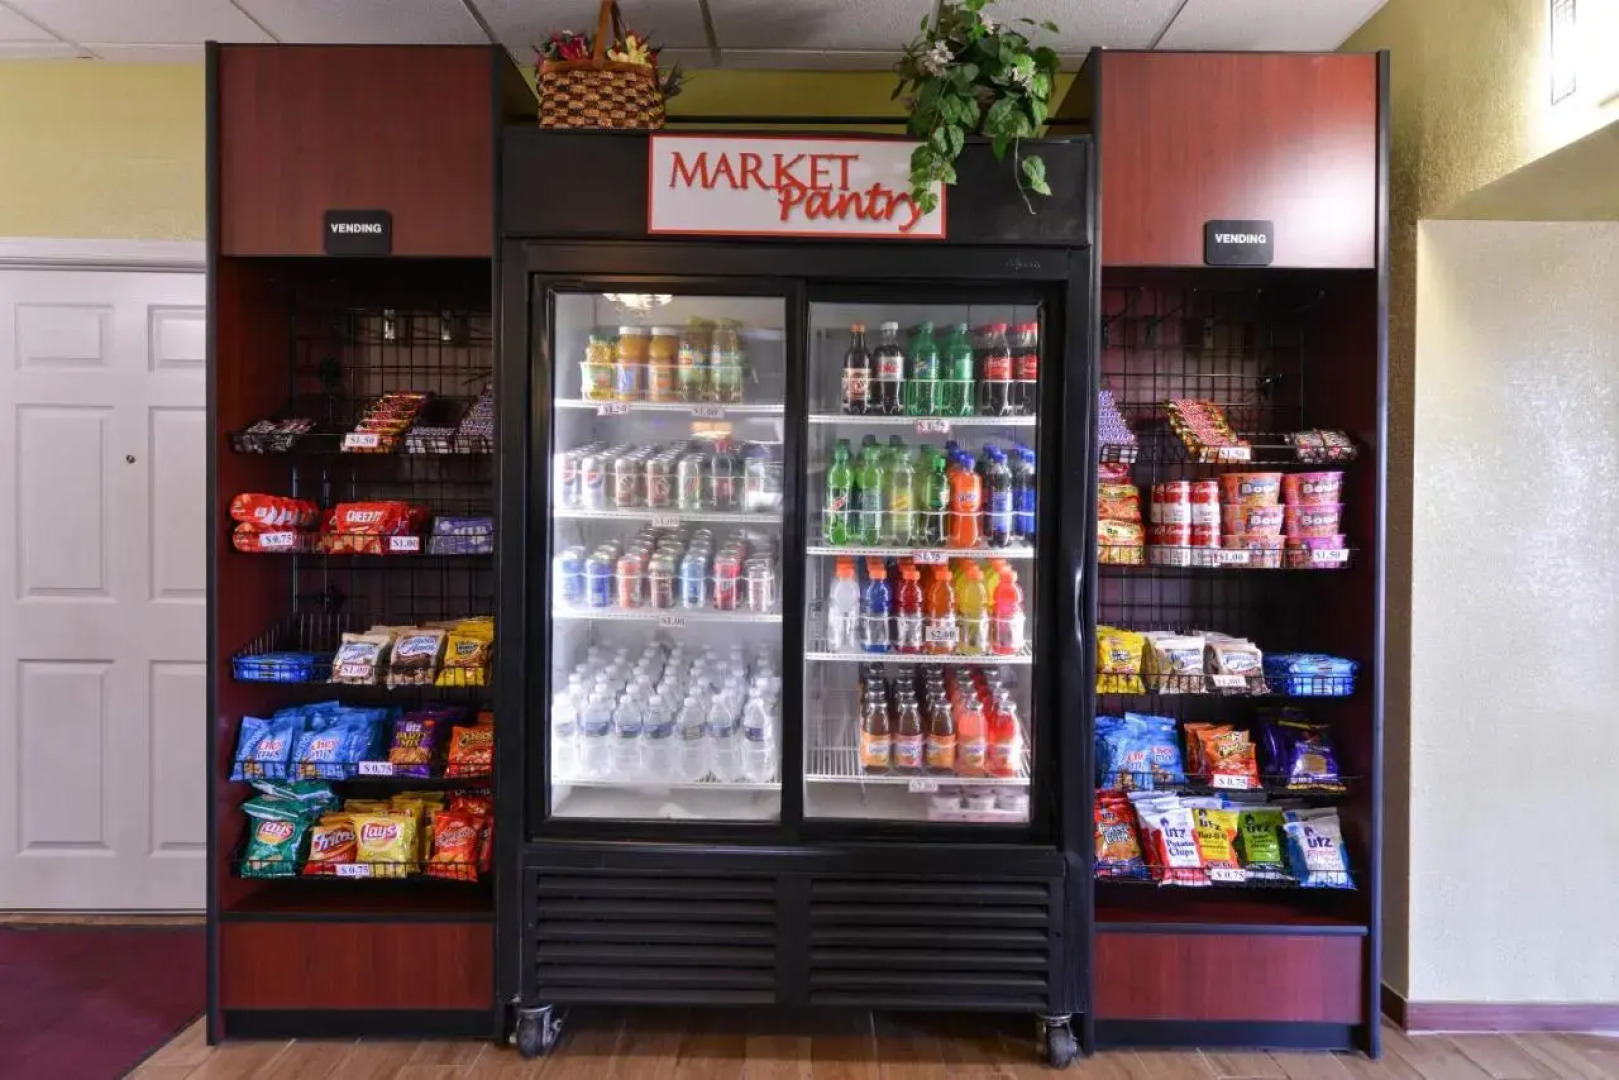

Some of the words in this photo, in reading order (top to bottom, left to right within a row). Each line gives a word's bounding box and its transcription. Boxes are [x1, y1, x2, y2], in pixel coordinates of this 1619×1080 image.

[669, 151, 859, 190] MARKET
[778, 181, 923, 232] Pantry
[331, 223, 381, 233] VENDING
[1215, 233, 1266, 243] VENDING
